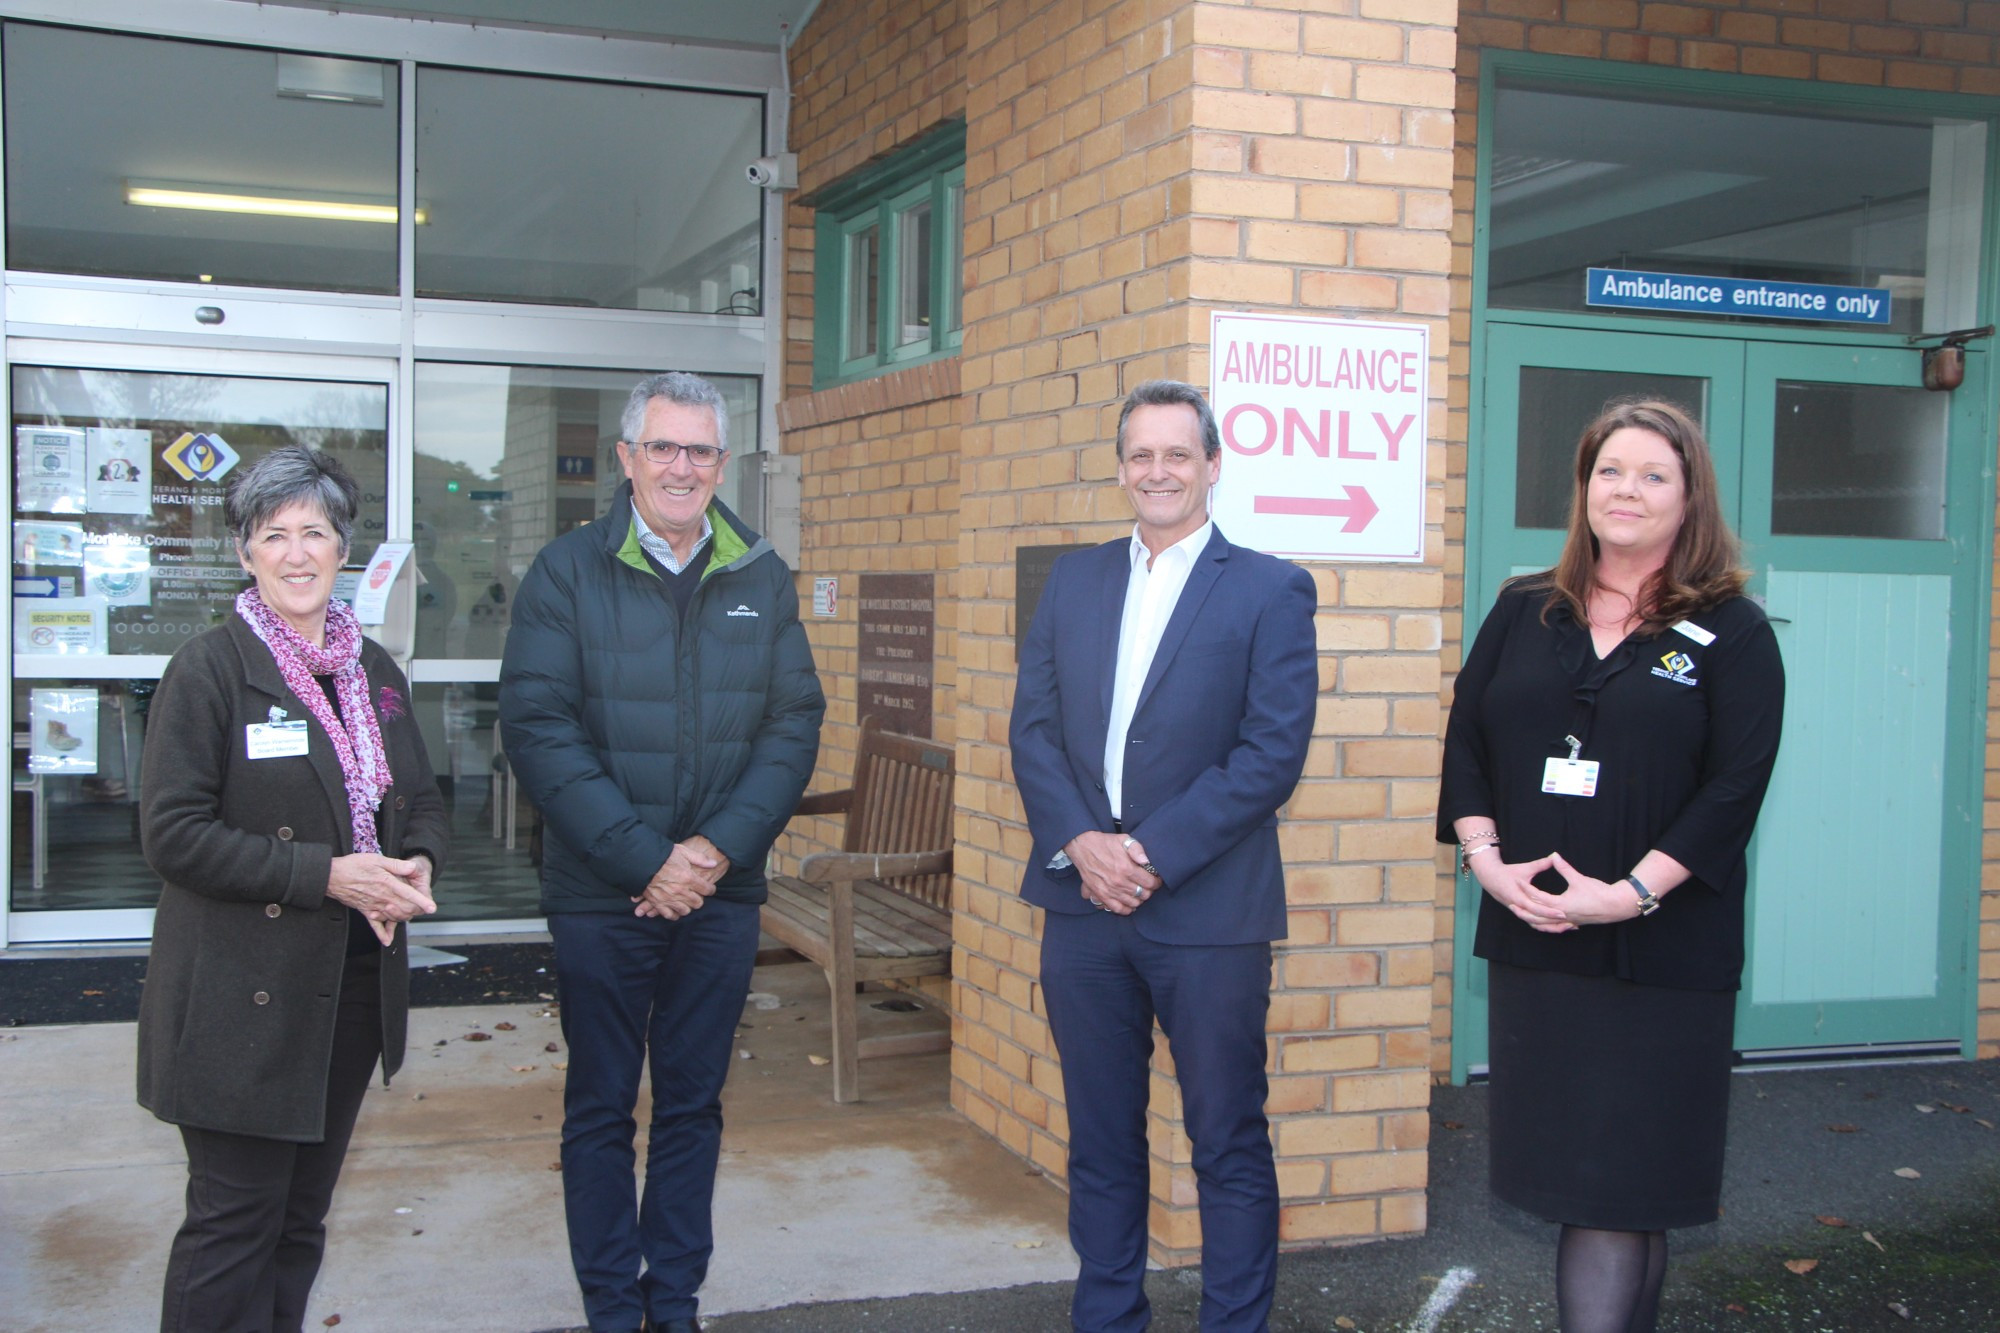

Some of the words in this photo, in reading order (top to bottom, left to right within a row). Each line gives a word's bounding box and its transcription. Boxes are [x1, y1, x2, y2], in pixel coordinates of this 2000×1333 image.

[1602, 274, 1722, 303] Ambulance
[1733, 287, 1826, 311] entrance
[1836, 293, 1880, 318] only
[1222, 340, 1418, 394] AMBULANCE
[1222, 403, 1417, 462] ONLY
[154, 485, 188, 494] TERANG
[202, 487, 226, 495] MORT
[152, 494, 196, 505] HEALTH
[200, 495, 225, 506] SER
[82, 531, 140, 546] Mortlake
[144, 534, 220, 550] Community
[158, 568, 199, 578] OFFICE
[203, 569, 244, 578] HOURS
[157, 591, 200, 600] MONDAY
[208, 592, 237, 600] FRIDA
[32, 614, 64, 622] SECURITY
[66, 615, 91, 623] NOTICE
